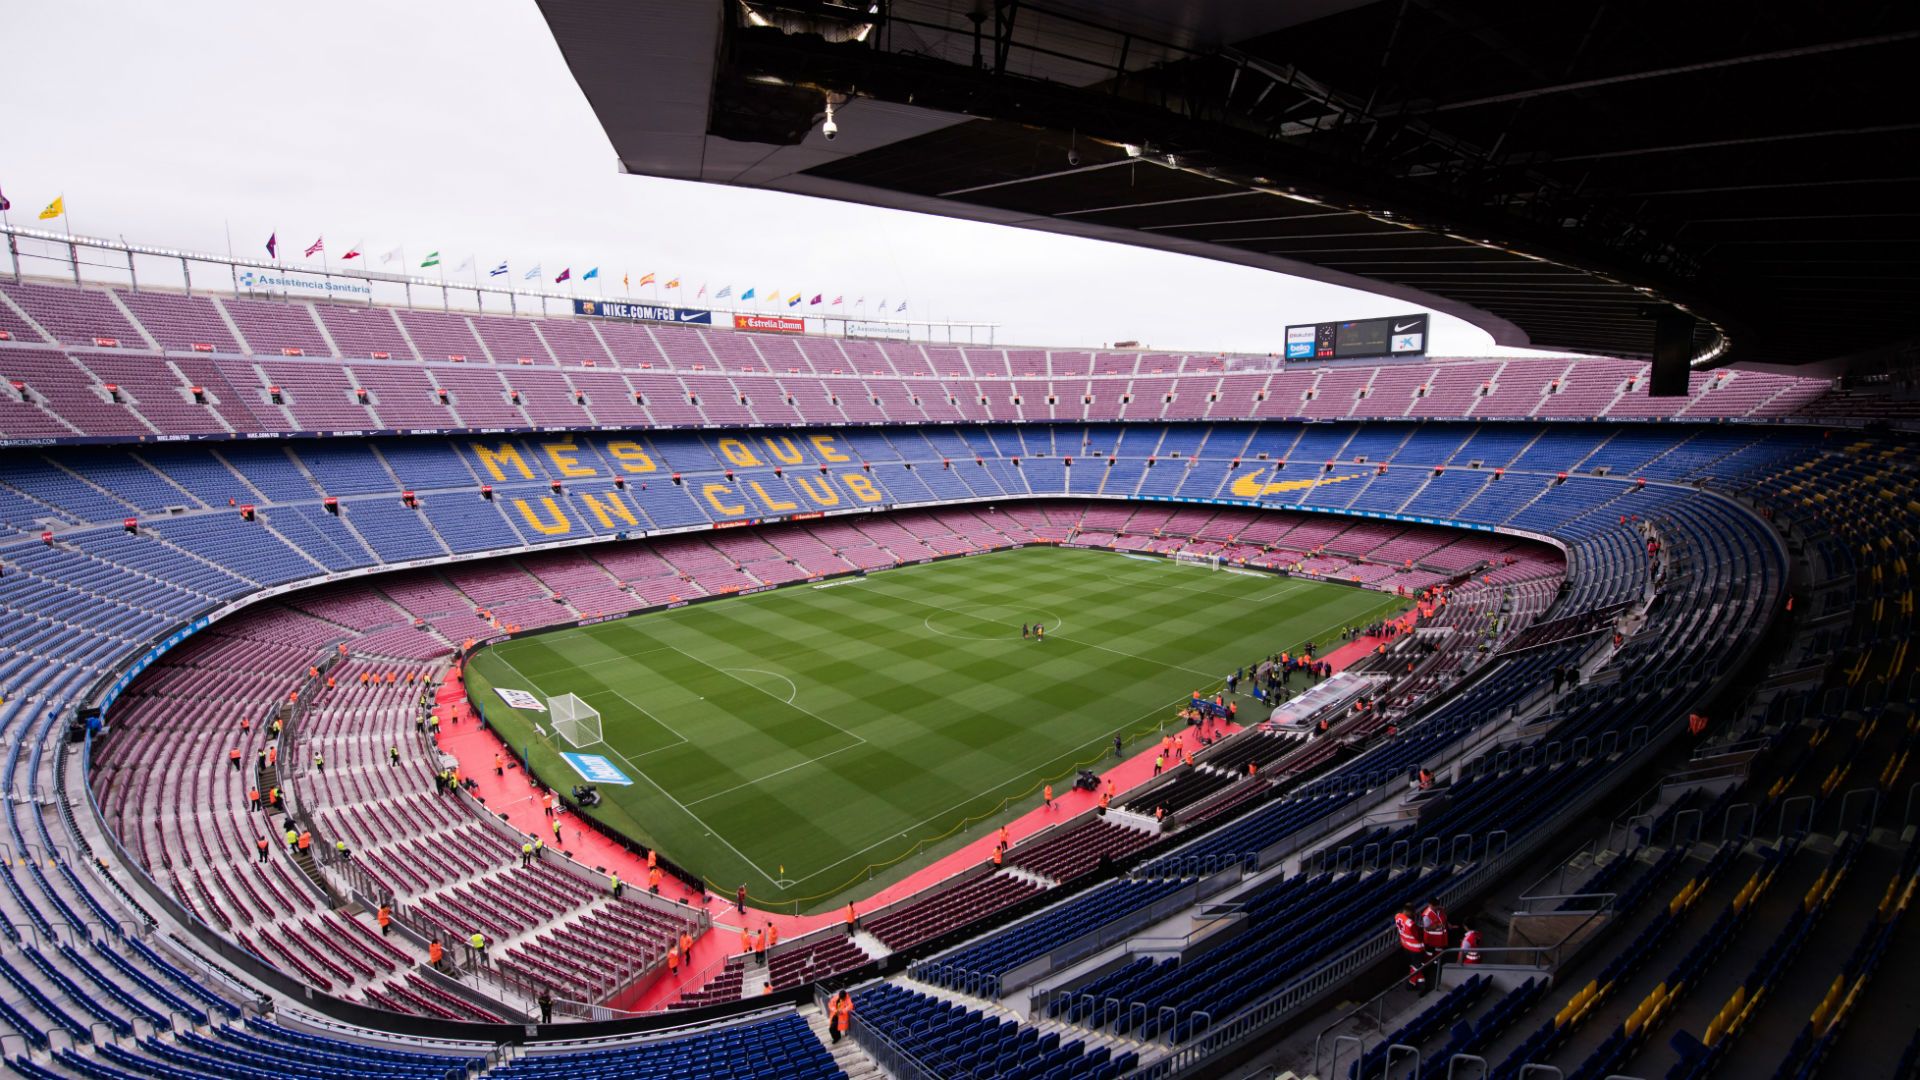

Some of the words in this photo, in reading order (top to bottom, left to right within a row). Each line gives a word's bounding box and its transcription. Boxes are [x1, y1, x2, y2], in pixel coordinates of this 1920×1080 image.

[602, 304, 675, 320] NIKE.COM/FCB
[748, 318, 778, 328] Estrella
[778, 320, 802, 330] Damm
[1290, 344, 1310, 352] beko
[470, 434, 657, 481] MÉS
[718, 435, 851, 467] QUE
[511, 491, 639, 535] UN
[702, 474, 883, 516] CLUB
